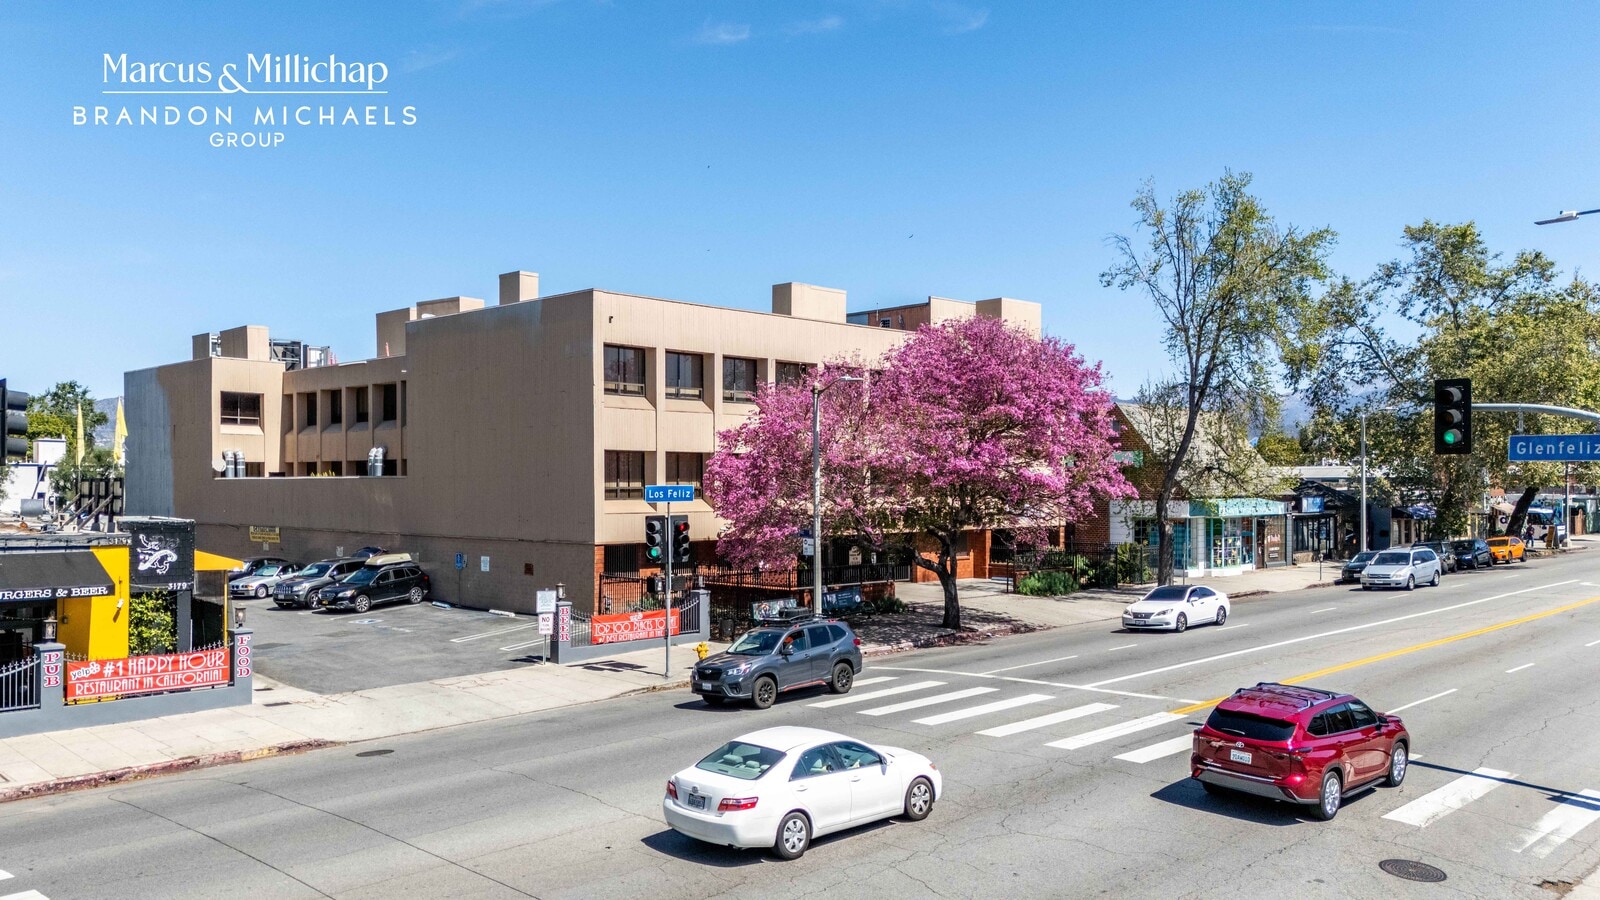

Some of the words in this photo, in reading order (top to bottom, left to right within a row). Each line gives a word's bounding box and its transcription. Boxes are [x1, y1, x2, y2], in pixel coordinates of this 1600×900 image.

[1516, 441, 1600, 455] Glenfeliz
[649, 489, 664, 498] Los
[668, 489, 691, 498] Feliz
[56, 588, 68, 597] &
[71, 586, 109, 596] BEER
[168, 582, 187, 590] 3179
[559, 607, 570, 641] BEER
[43, 652, 61, 687] PUB
[71, 667, 91, 680] yelp
[103, 661, 123, 678] #1
[128, 656, 175, 675] HAPPY
[179, 652, 225, 671] HOUR
[237, 635, 251, 677] FOOD
[75, 677, 139, 696] RESTAURANT
[143, 676, 153, 689] IN
[156, 669, 223, 688] CALIFORNIA!
